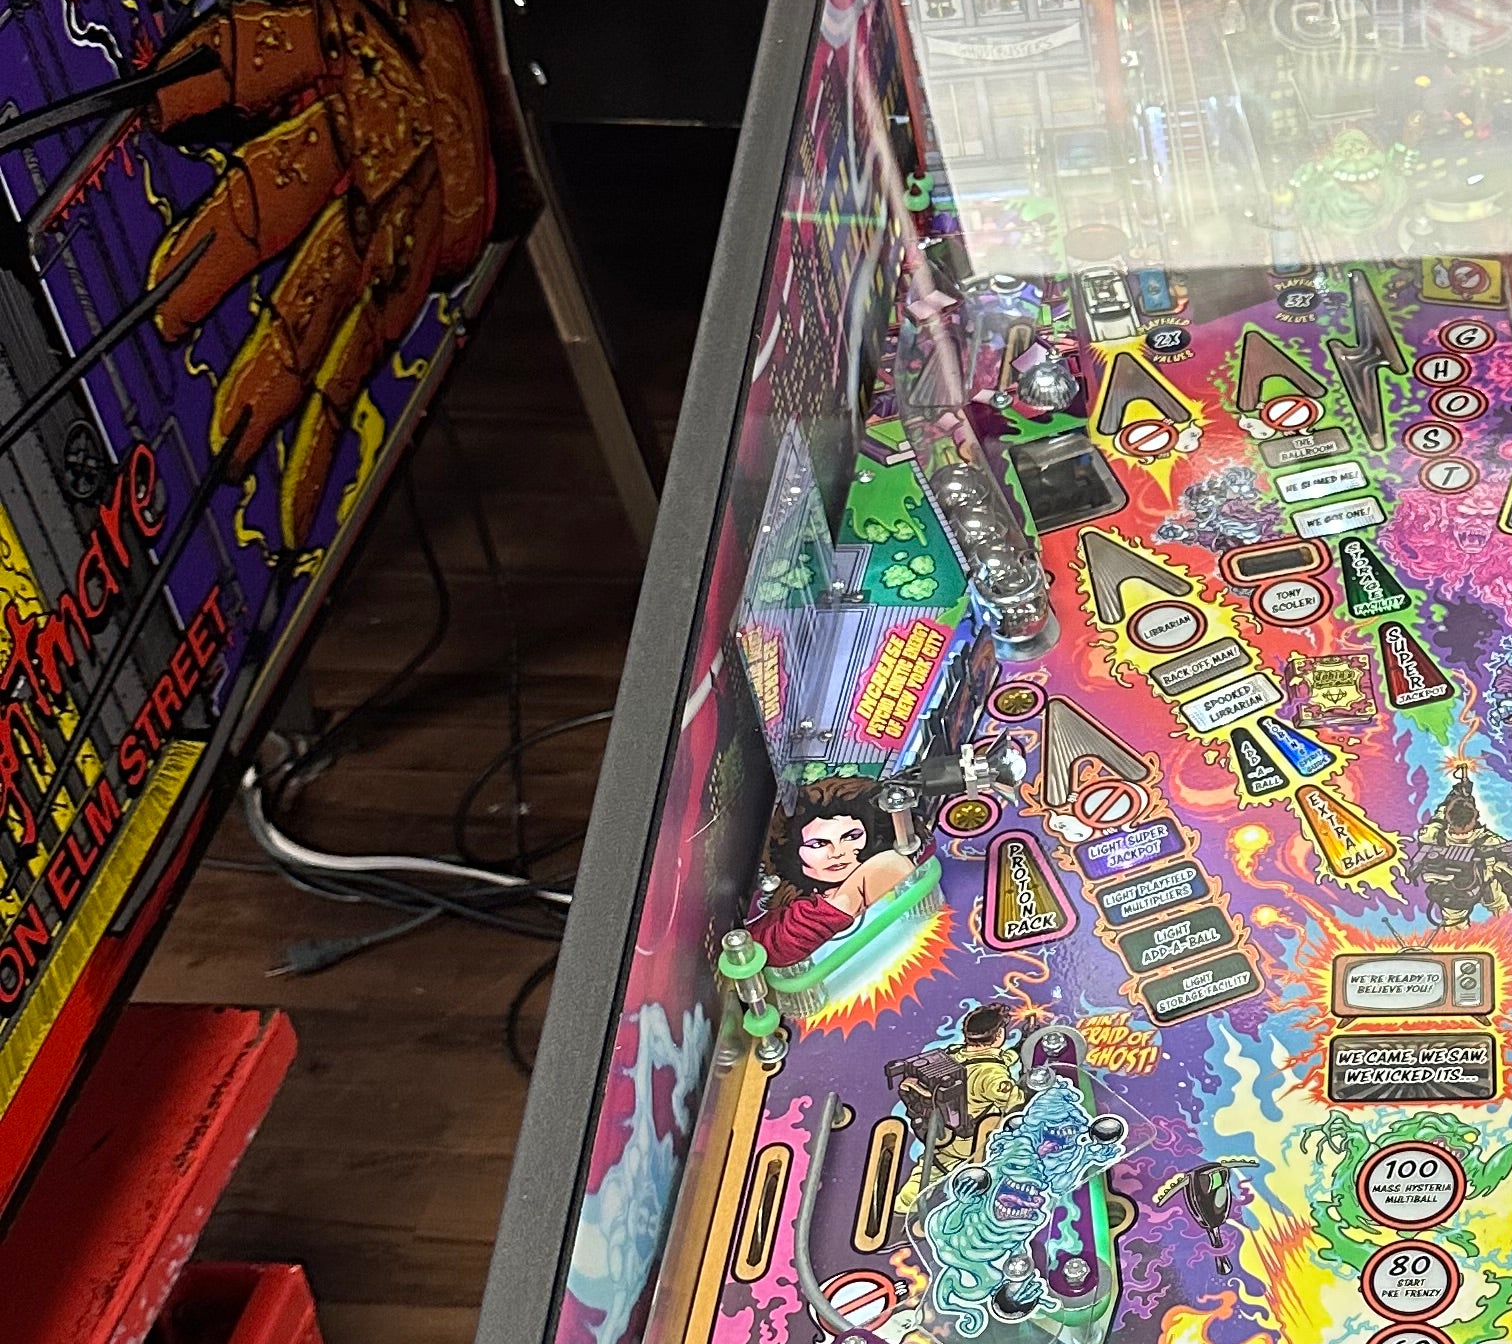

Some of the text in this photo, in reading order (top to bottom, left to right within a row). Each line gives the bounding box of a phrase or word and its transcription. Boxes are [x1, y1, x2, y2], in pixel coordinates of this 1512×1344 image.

[1154, 330, 1182, 350] 2X
[1281, 444, 1335, 461] BALLROOM
[1271, 597, 1317, 614] SCOLERI
[1276, 588, 1302, 601] TONY
[1144, 615, 1192, 640] LIBRARIAN
[906, 629, 946, 690] YORK CITY
[1162, 645, 1238, 686] BACK MAN!
[1387, 628, 1425, 690] SUPER
[119, 586, 229, 786] STREET
[857, 633, 906, 720] INCREASE
[1203, 684, 1252, 712] SPOOKED
[1397, 685, 1448, 705] JACKPOT
[885, 689, 918, 738] OF NEW
[1209, 693, 1264, 723] LIBRARIAN
[1242, 741, 1261, 766] ADD
[1253, 777, 1284, 792] BALL
[1308, 792, 1357, 852] EXTRA
[47, 778, 123, 910] ELM
[1090, 826, 1167, 857] LIGHT SUPER
[1109, 842, 1161, 866] JACKPOT
[1341, 843, 1385, 871] BALL
[1007, 843, 1035, 918] PROTON
[1104, 869, 1196, 906] LIGHT PLAYFIELD
[1122, 886, 1192, 916] MULTIPLIERS
[1004, 912, 1057, 938] PACK
[1155, 922, 1190, 943] LIGHT
[0, 904, 49, 1003] ON
[1142, 929, 1220, 964] ADD-A-BALL
[1184, 972, 1213, 989] LIGHT
[1350, 973, 1440, 984] WE'RE READY TO
[1356, 984, 1434, 994] BELIEVE YOU!
[1158, 973, 1251, 1013] STORAGE FACILITY
[1086, 1046, 1158, 1073] GHOST!
[1338, 1048, 1488, 1065] WE CAME, WE SAW,
[1346, 1069, 1373, 1083] WE
[1374, 1068, 1434, 1083] KICKED
[1384, 1159, 1439, 1179] 100
[1372, 1183, 1452, 1193] MASS HYSTERIA
[1385, 1194, 1438, 1204] MULTIBALL
[1388, 1255, 1431, 1276] 80
[1381, 1288, 1442, 1299] PKE FRENZY
[1397, 1278, 1425, 1287] START
